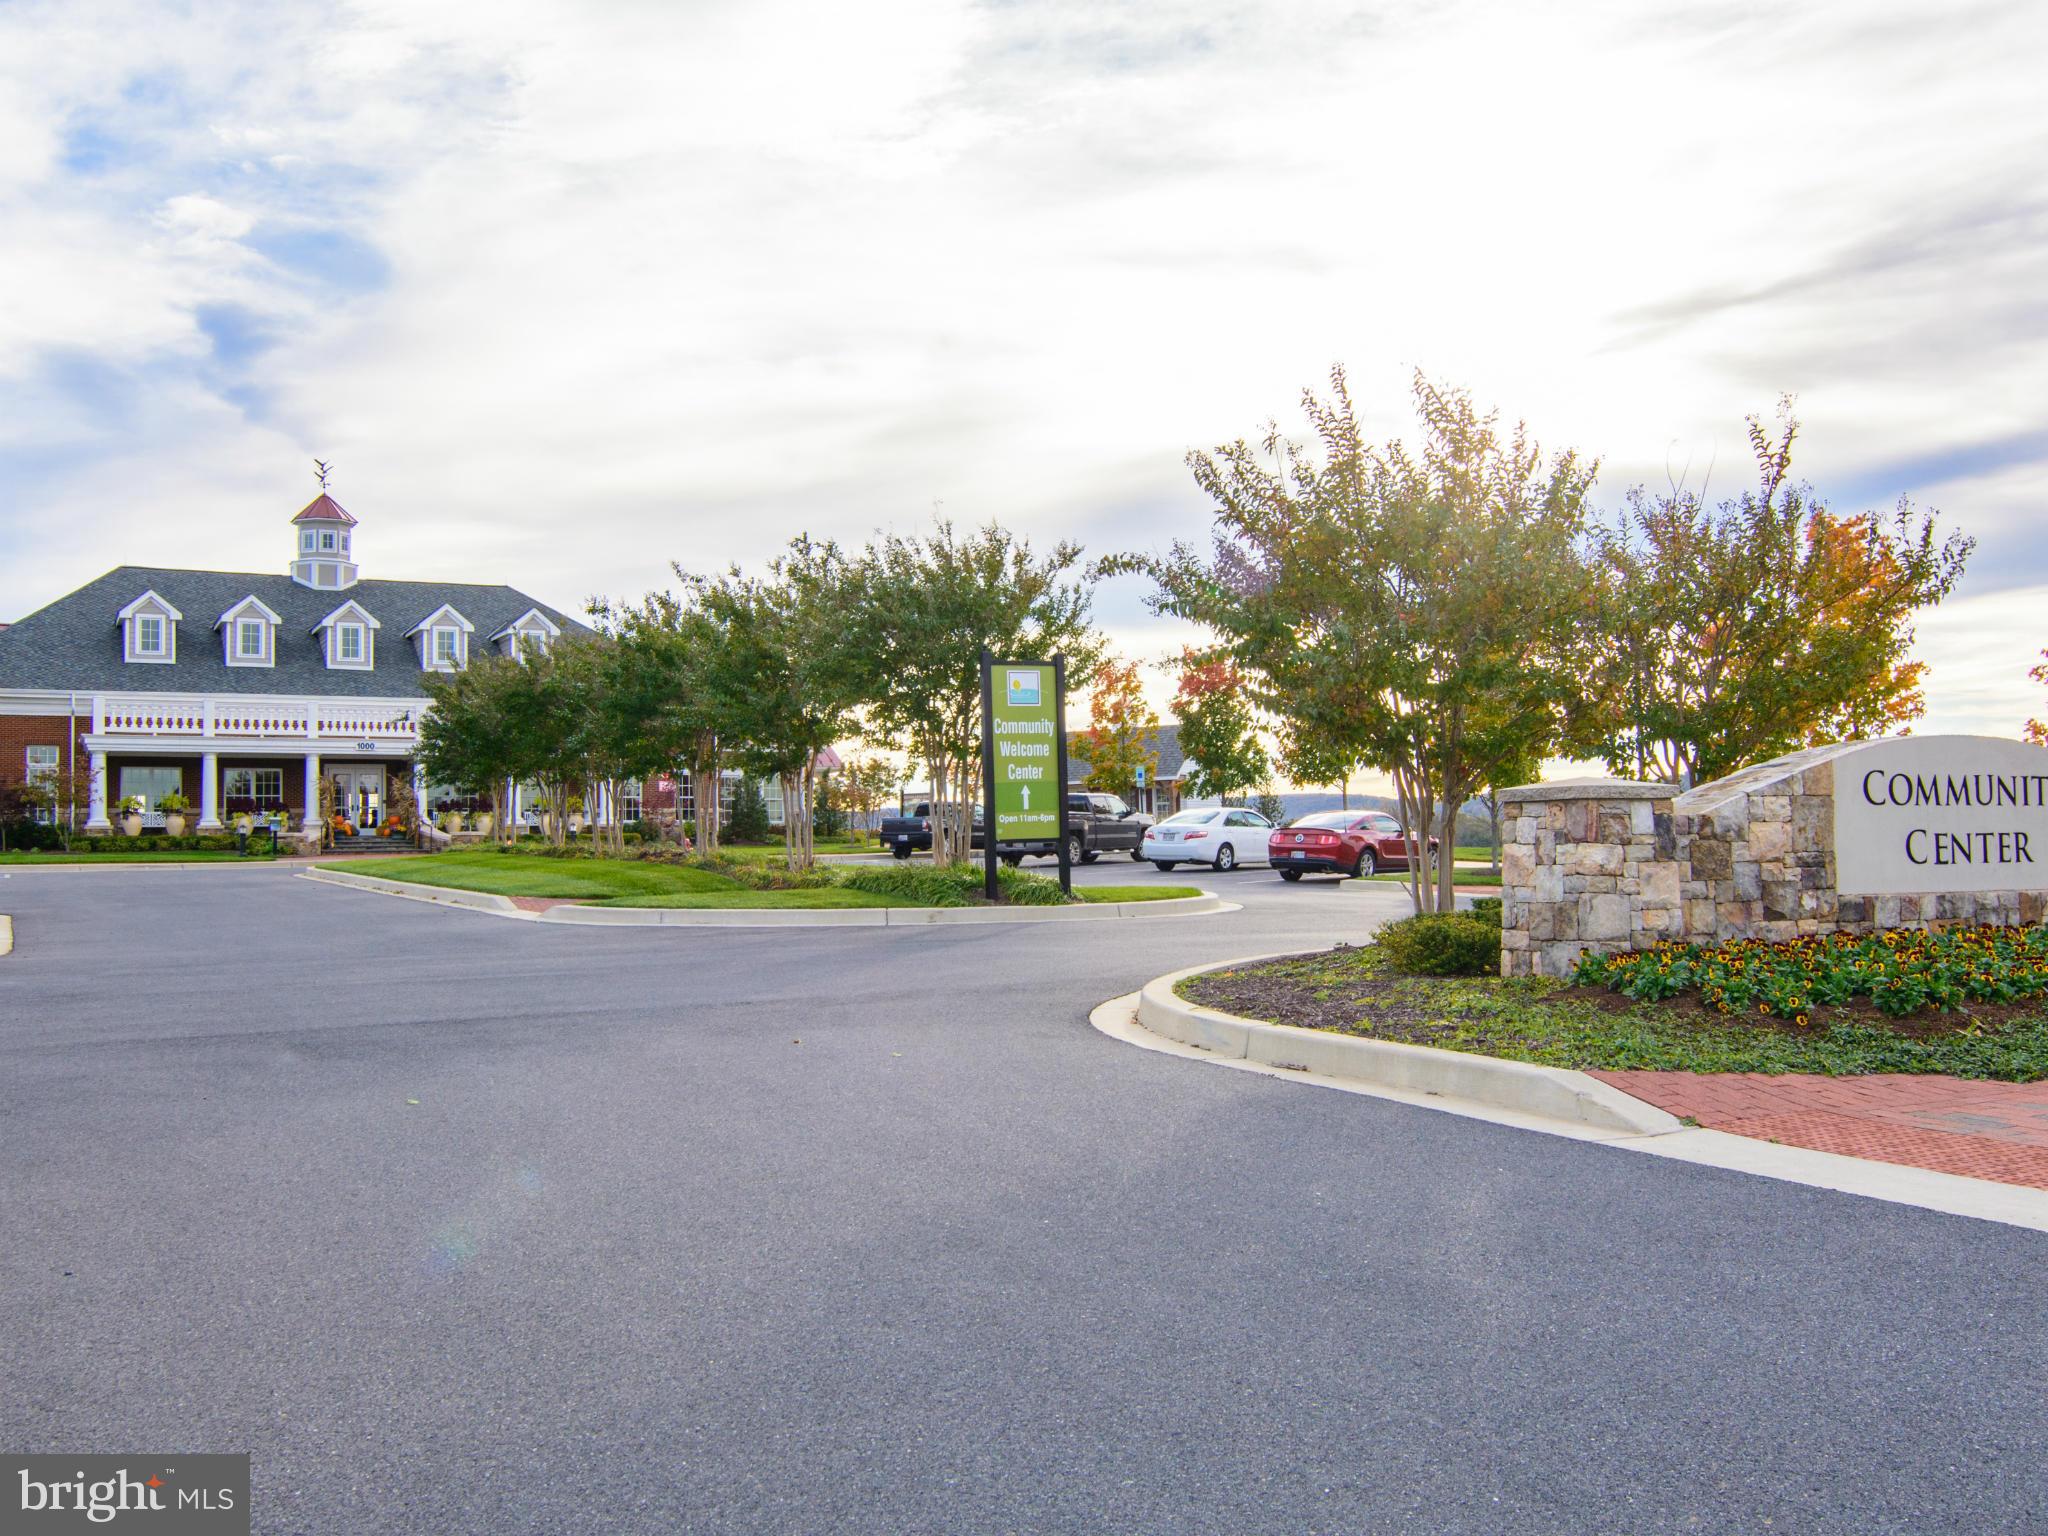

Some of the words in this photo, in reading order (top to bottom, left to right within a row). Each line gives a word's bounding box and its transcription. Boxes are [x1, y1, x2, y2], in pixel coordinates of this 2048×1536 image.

[993, 718, 1054, 737] Community
[357, 742, 375, 750] 1000
[1000, 741, 1050, 757] Welcome
[1008, 763, 1043, 780] Center
[999, 814, 1018, 824] Open
[1019, 814, 1056, 823] 11am-6pm
[1905, 829, 2034, 865] CENTER
